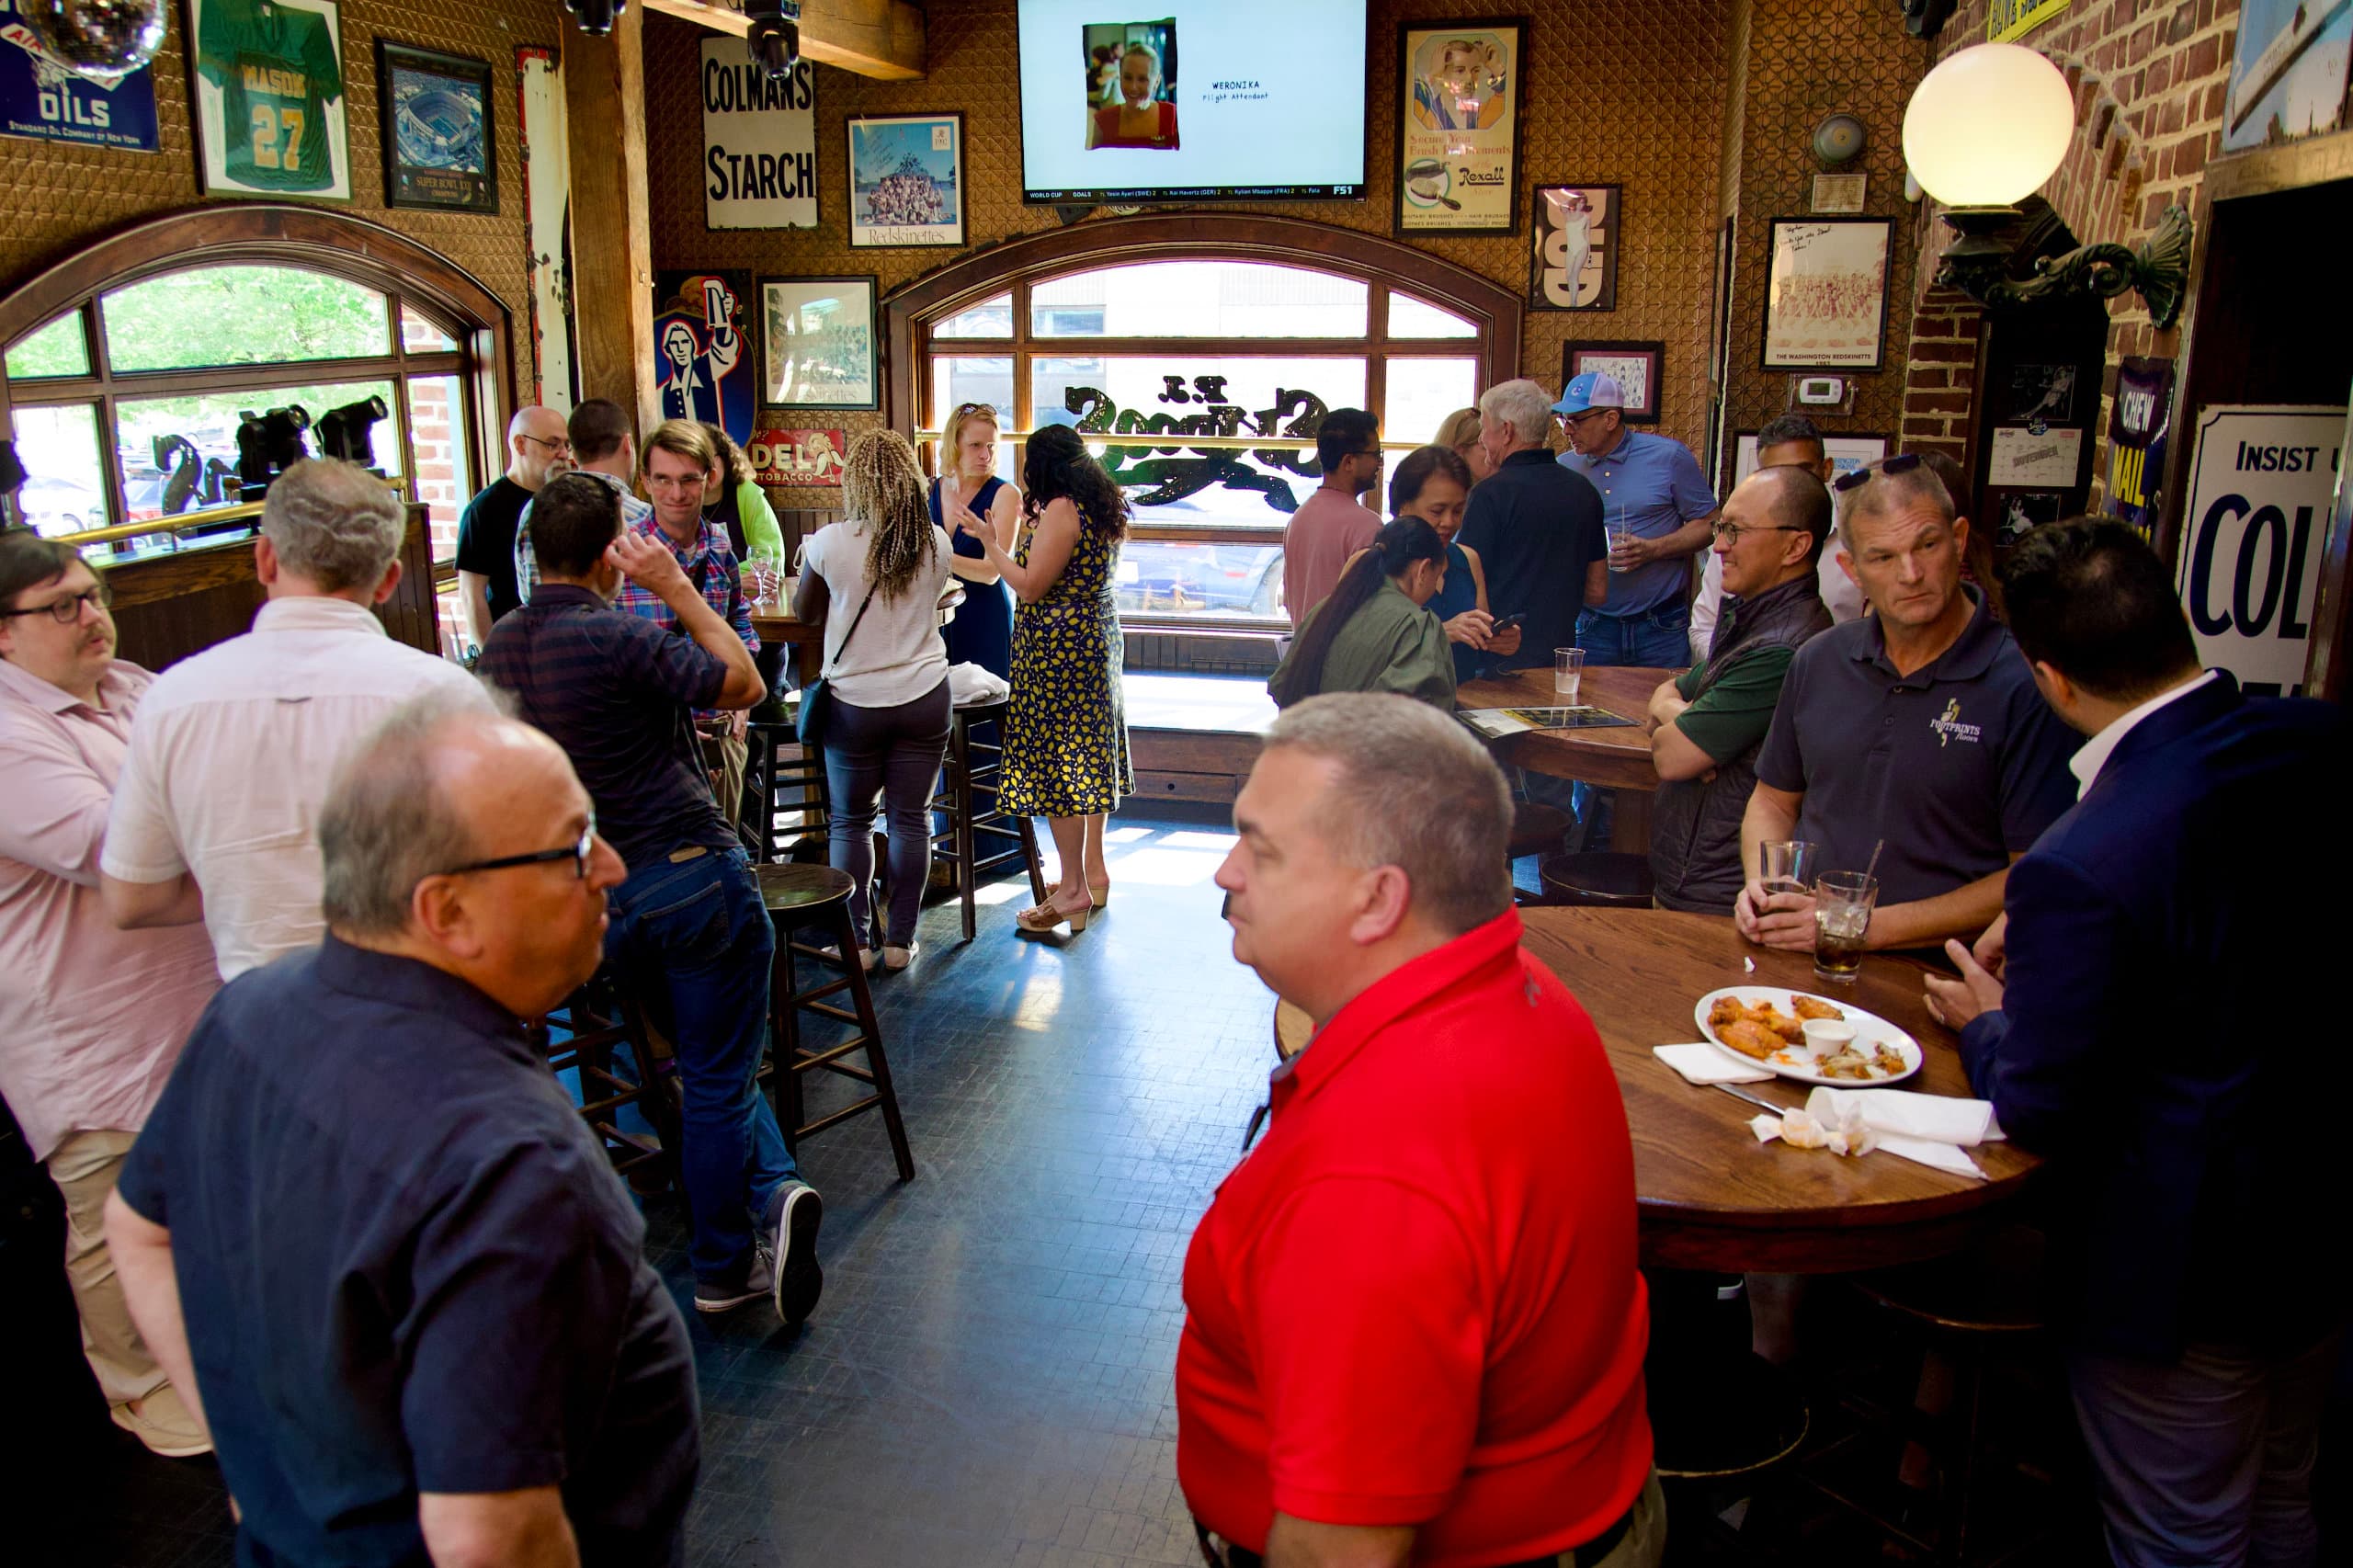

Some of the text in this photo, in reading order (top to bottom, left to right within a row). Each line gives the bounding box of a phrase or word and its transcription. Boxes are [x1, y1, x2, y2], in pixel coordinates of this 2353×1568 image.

[243, 64, 306, 98] MASON
[1212, 81, 1260, 90] WERONIKA
[39, 91, 110, 127] OILS
[1232, 92, 1267, 100] Attendant
[251, 104, 305, 171] 27
[708, 145, 813, 201] STARCH
[1459, 165, 1506, 187] Rexall
[1333, 185, 1353, 195] FS1
[869, 226, 947, 245] Redskinettes
[2123, 391, 2155, 433] CHEW
[752, 443, 813, 470] DEL
[2235, 440, 2320, 472] INSIST
[757, 472, 813, 482] TOBACCO
[2109, 444, 2146, 507] MAIL
[2189, 493, 2333, 640] COL
[1929, 718, 1982, 736] FOOTPRINTS
